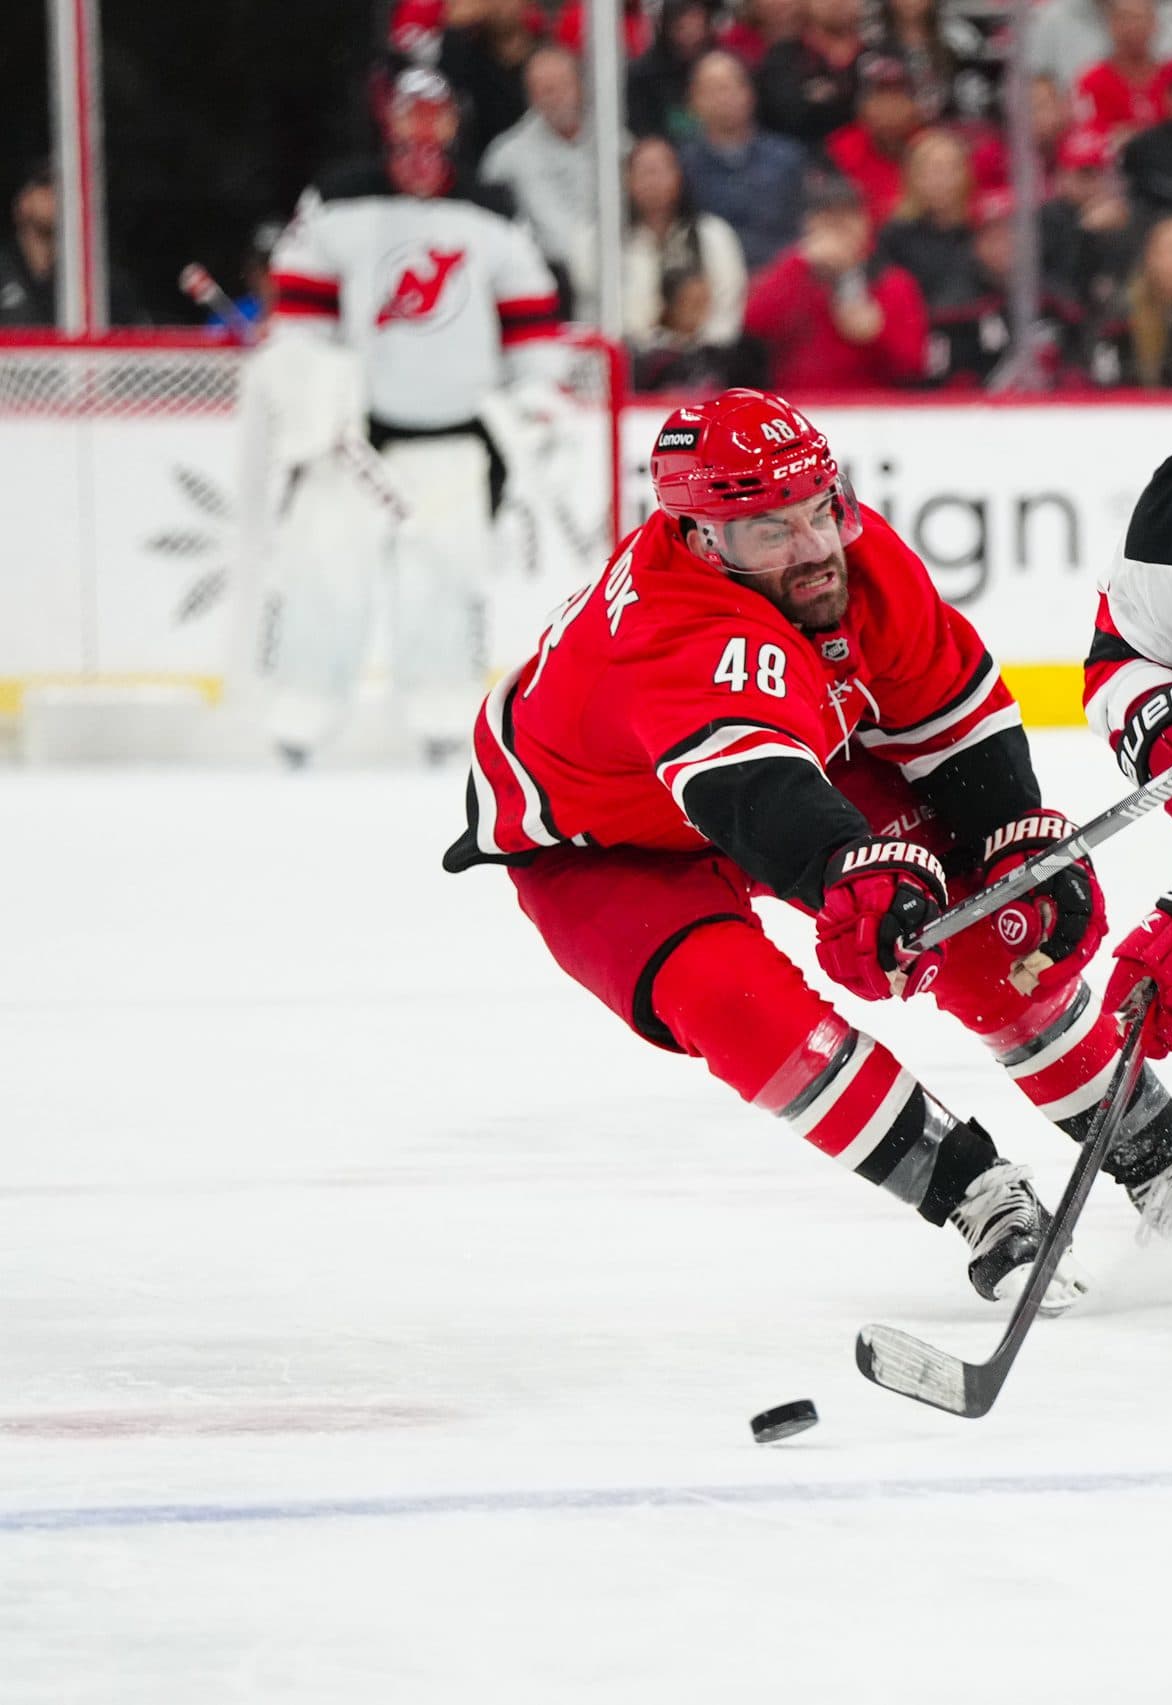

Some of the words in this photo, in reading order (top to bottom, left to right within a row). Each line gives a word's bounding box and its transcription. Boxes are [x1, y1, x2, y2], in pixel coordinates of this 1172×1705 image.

[658, 433, 694, 447] Lenovo
[760, 418, 796, 444] 48
[772, 454, 818, 480] CCM
[714, 637, 787, 698] 48
[879, 805, 936, 838] AUE
